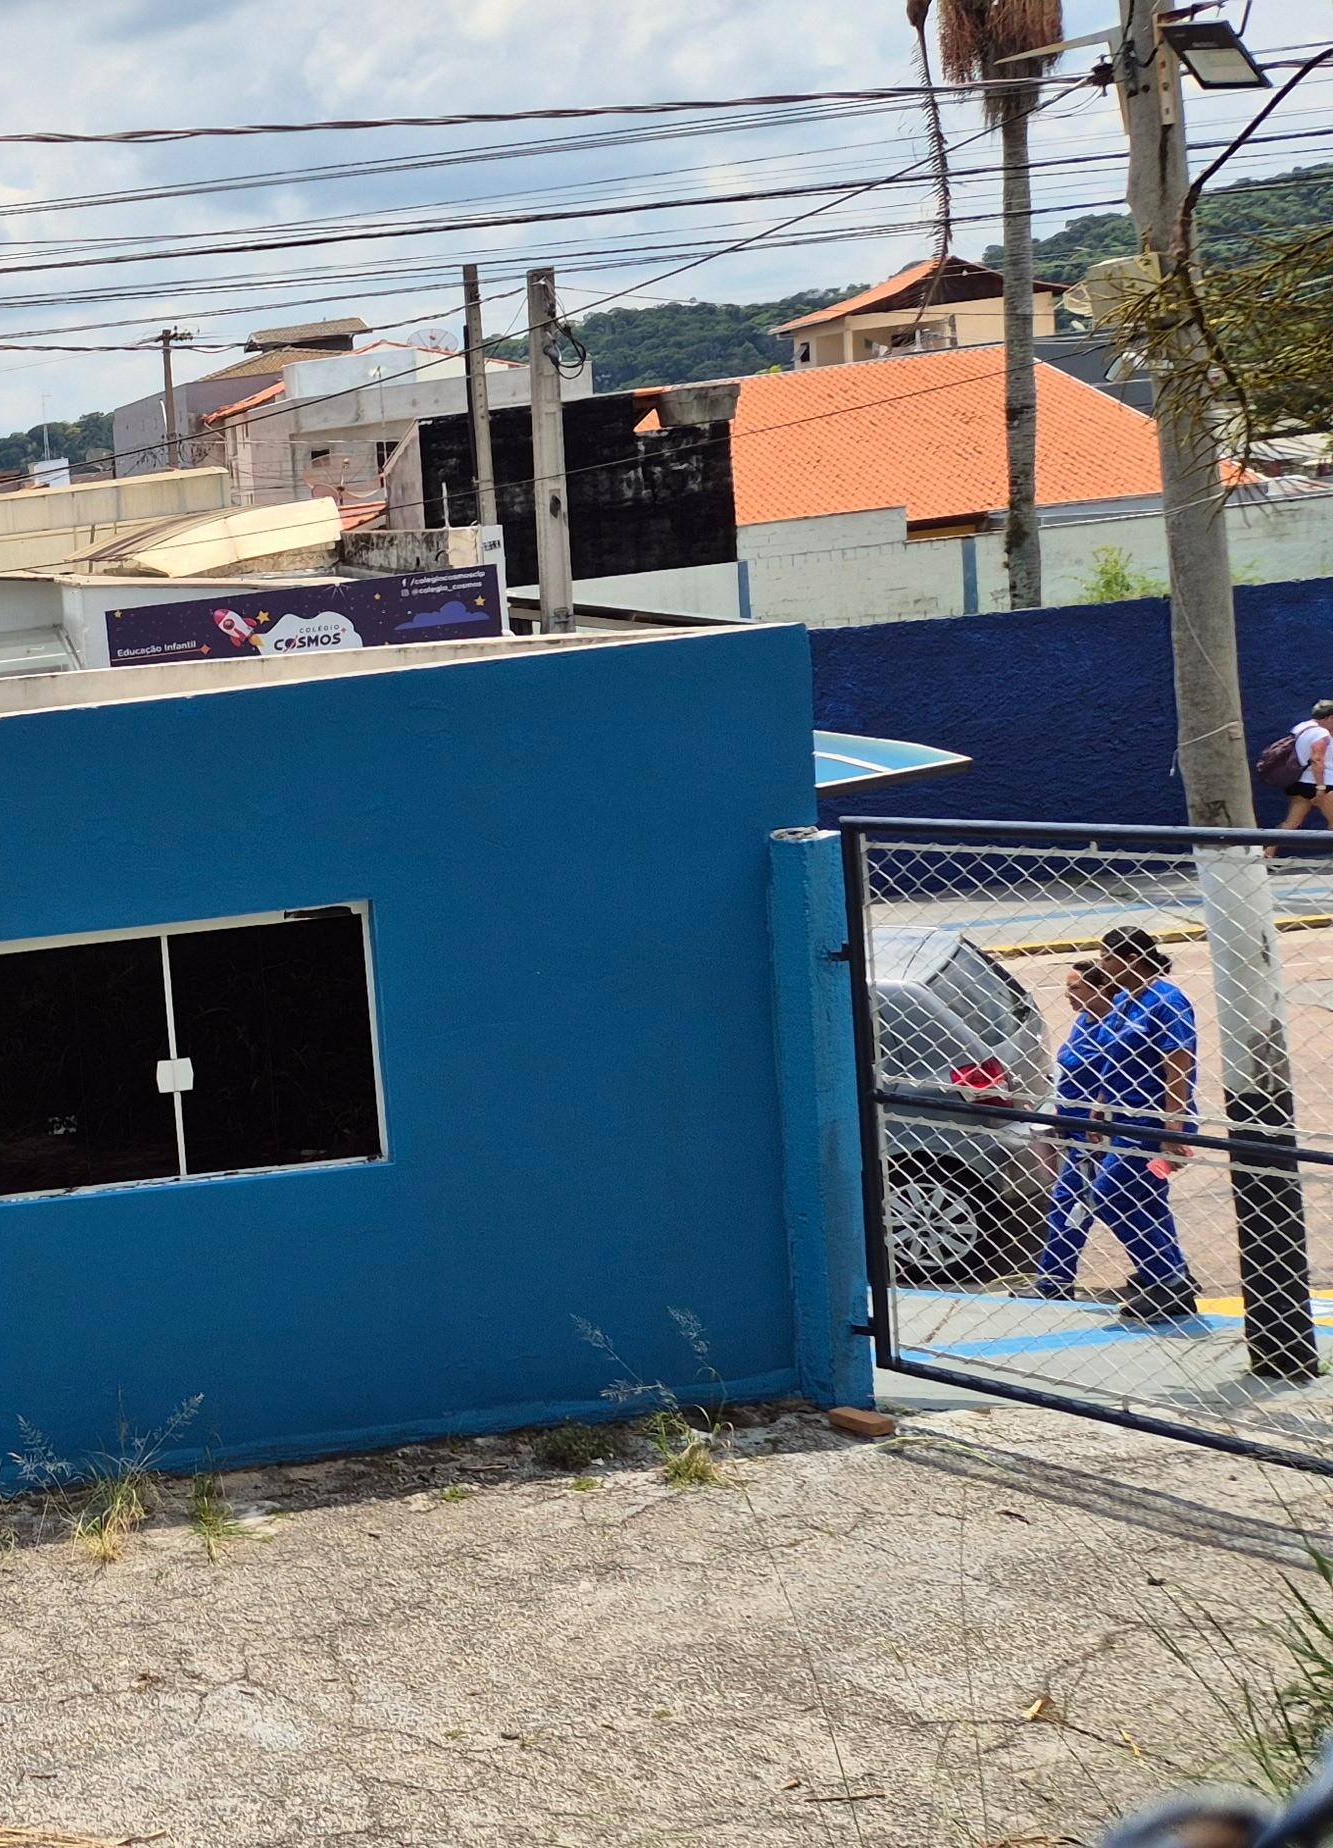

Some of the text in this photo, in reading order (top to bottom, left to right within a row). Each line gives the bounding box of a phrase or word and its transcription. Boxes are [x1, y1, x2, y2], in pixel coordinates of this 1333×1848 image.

[299, 624, 340, 634] COLÉGIO
[117, 640, 197, 658] Educação Infantil
[273, 632, 342, 652] COSMOS
